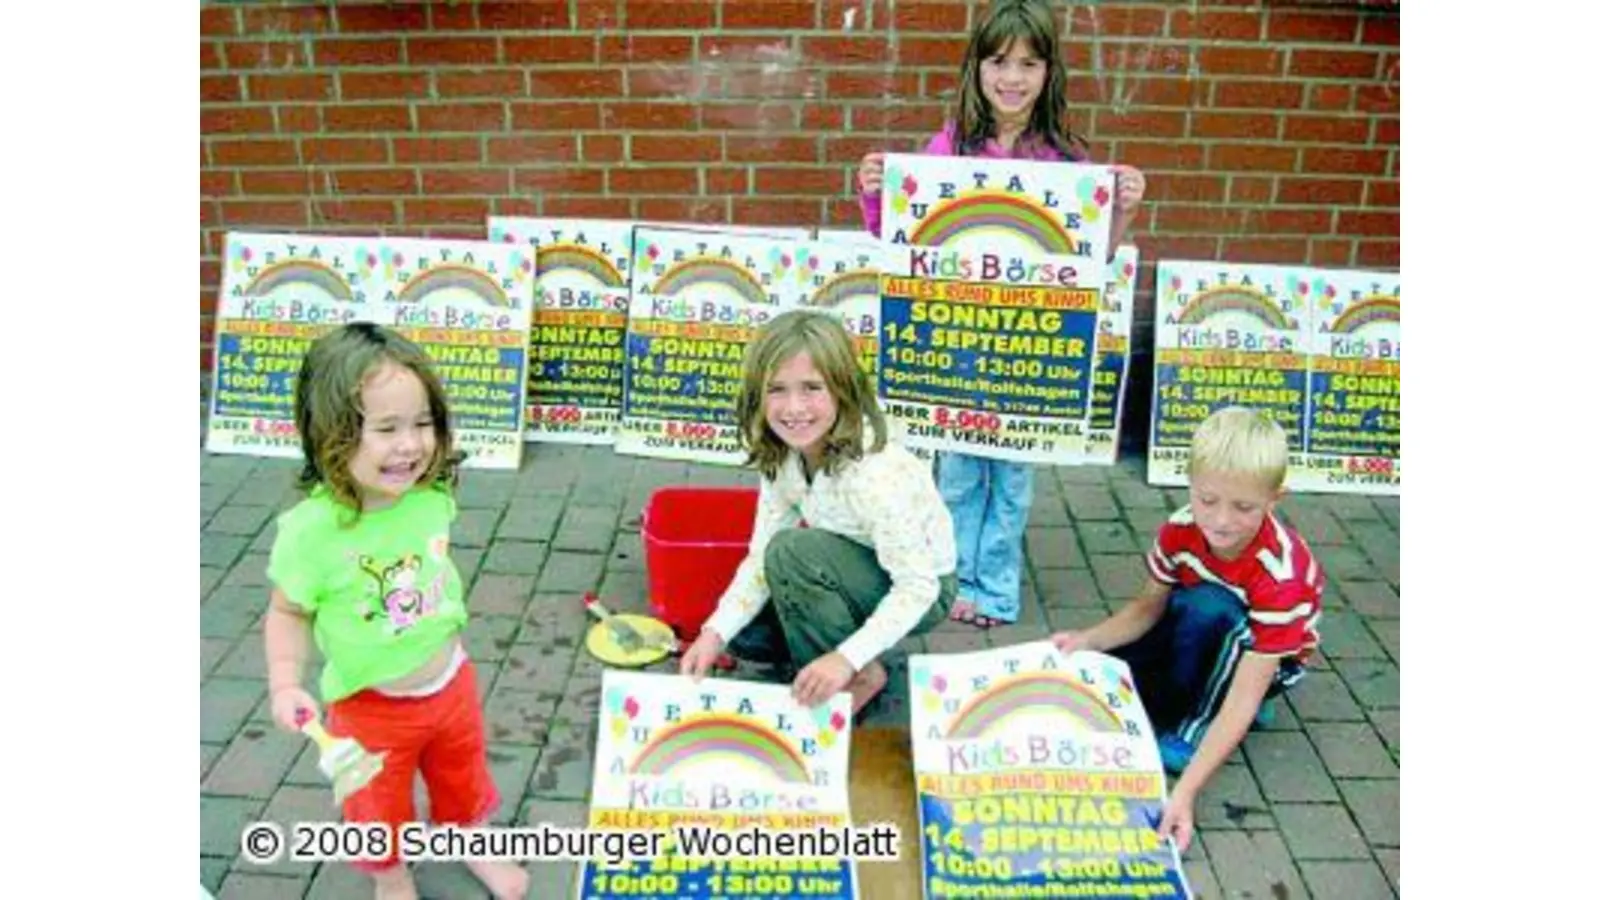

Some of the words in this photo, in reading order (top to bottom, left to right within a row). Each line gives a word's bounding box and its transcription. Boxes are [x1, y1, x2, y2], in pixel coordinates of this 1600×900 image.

[890, 172, 1094, 258] AUETALER
[909, 249, 973, 280] Kids
[980, 253, 1079, 288] Börse
[886, 279, 940, 298] ALLES
[945, 283, 994, 303] RUND
[999, 288, 1037, 306] UMS
[242, 299, 286, 320] Kids
[652, 298, 696, 319] Kids
[909, 301, 1065, 333] SONNTAG
[882, 322, 920, 344] 14.
[930, 328, 1087, 358] SEPTEMBER
[1177, 328, 1222, 347] Kids
[1330, 336, 1374, 359] Kids
[885, 347, 953, 370] 10:00
[976, 356, 1043, 380] 13:00
[1046, 364, 1082, 381] Uhr
[933, 406, 1002, 432] 8.000
[1006, 419, 1084, 437] ARTIKEL
[907, 423, 946, 439] ZUM
[951, 430, 1038, 452] VERKAUF
[926, 653, 1142, 741] AUETALER
[946, 744, 1020, 775] Kids
[1028, 735, 1132, 769] Börse
[628, 780, 700, 810] Kids
[709, 783, 819, 812] Börse
[952, 796, 1127, 826] SONNTAG
[980, 827, 1161, 855] SEPTEMBER
[591, 874, 679, 894] 10:00
[706, 874, 793, 894] 13:00
[797, 876, 842, 894] Uhr
